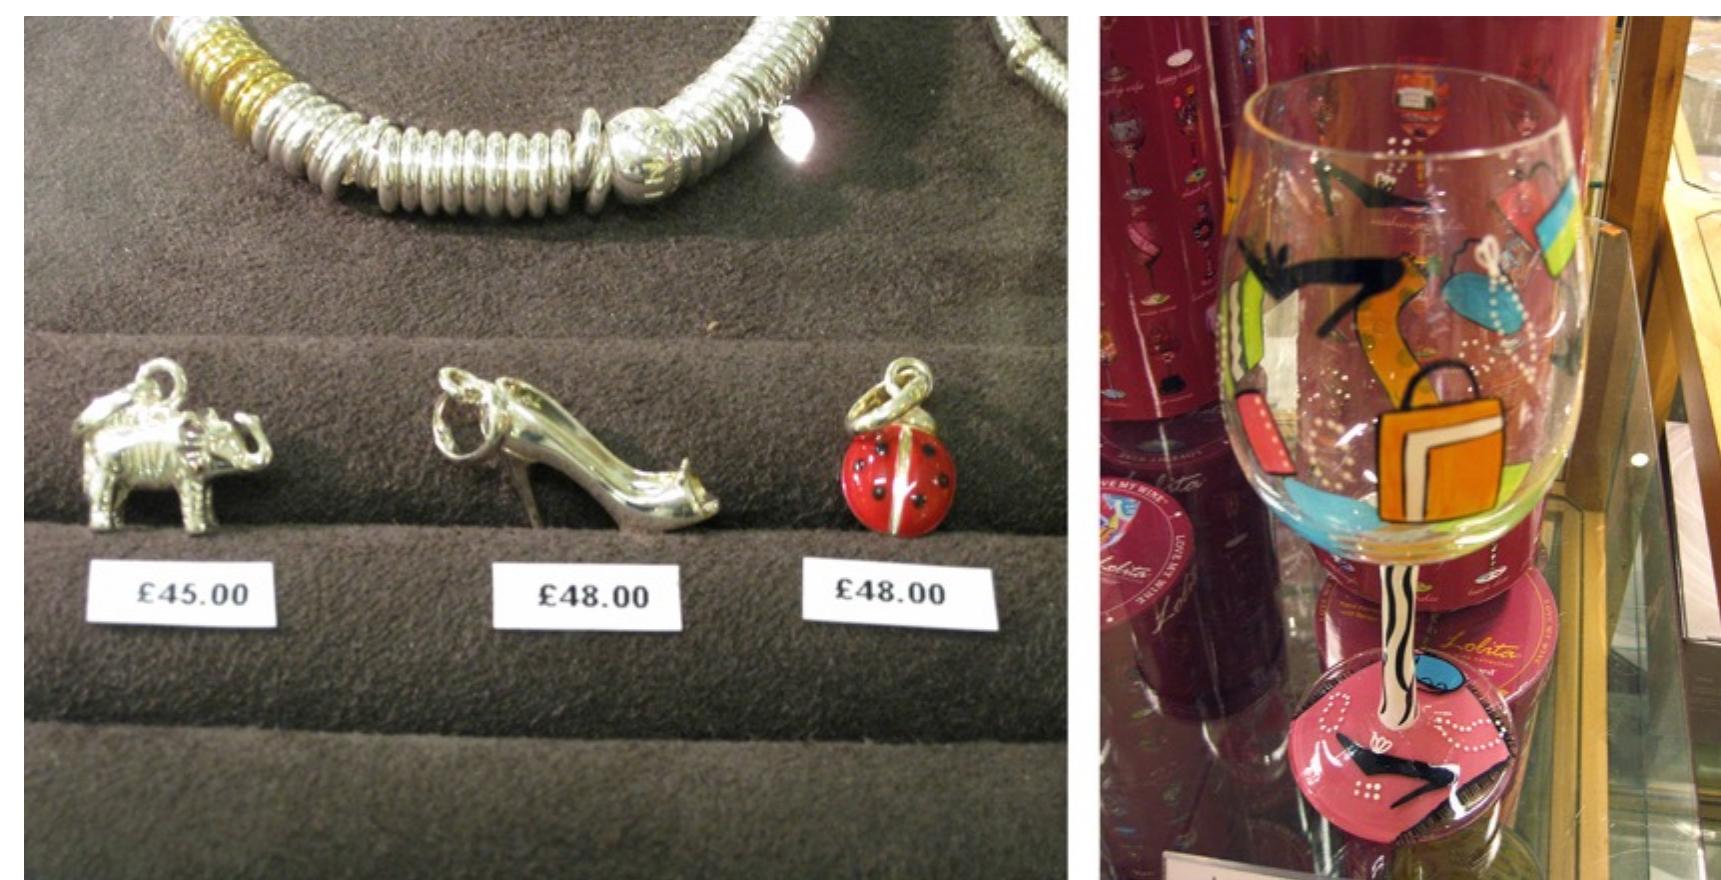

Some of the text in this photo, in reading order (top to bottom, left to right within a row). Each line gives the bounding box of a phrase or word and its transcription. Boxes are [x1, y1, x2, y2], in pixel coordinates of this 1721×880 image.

[1134, 535, 1185, 604] LOVE MY WINE
[138, 582, 249, 606] £45.00
[539, 584, 649, 608] £48.00
[836, 578, 946, 605] £48.00
[1443, 631, 1518, 658] Lolita
